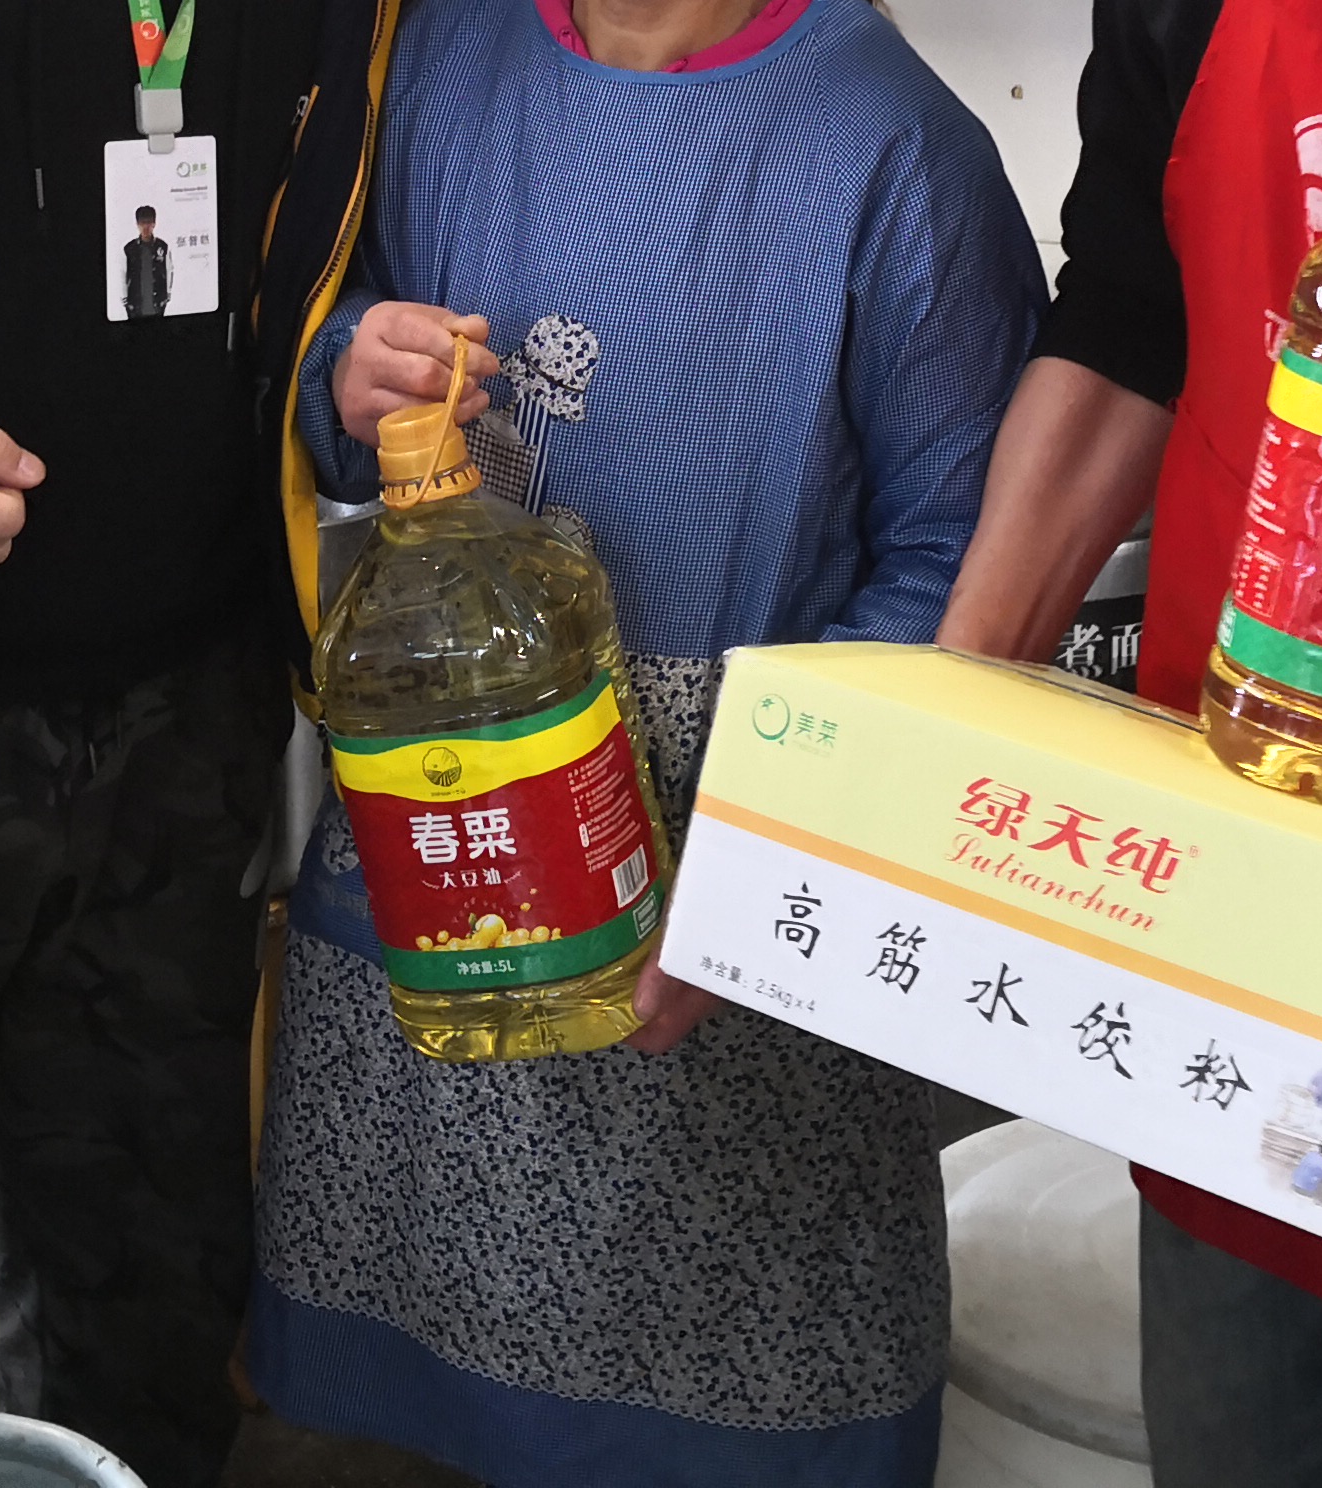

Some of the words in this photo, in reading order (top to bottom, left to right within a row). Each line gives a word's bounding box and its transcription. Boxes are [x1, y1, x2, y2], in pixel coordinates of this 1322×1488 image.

[438, 867, 502, 889] 大豆油
[954, 776, 1184, 894] 绿天纯
[775, 881, 1254, 1110] 高筋水饺粉
